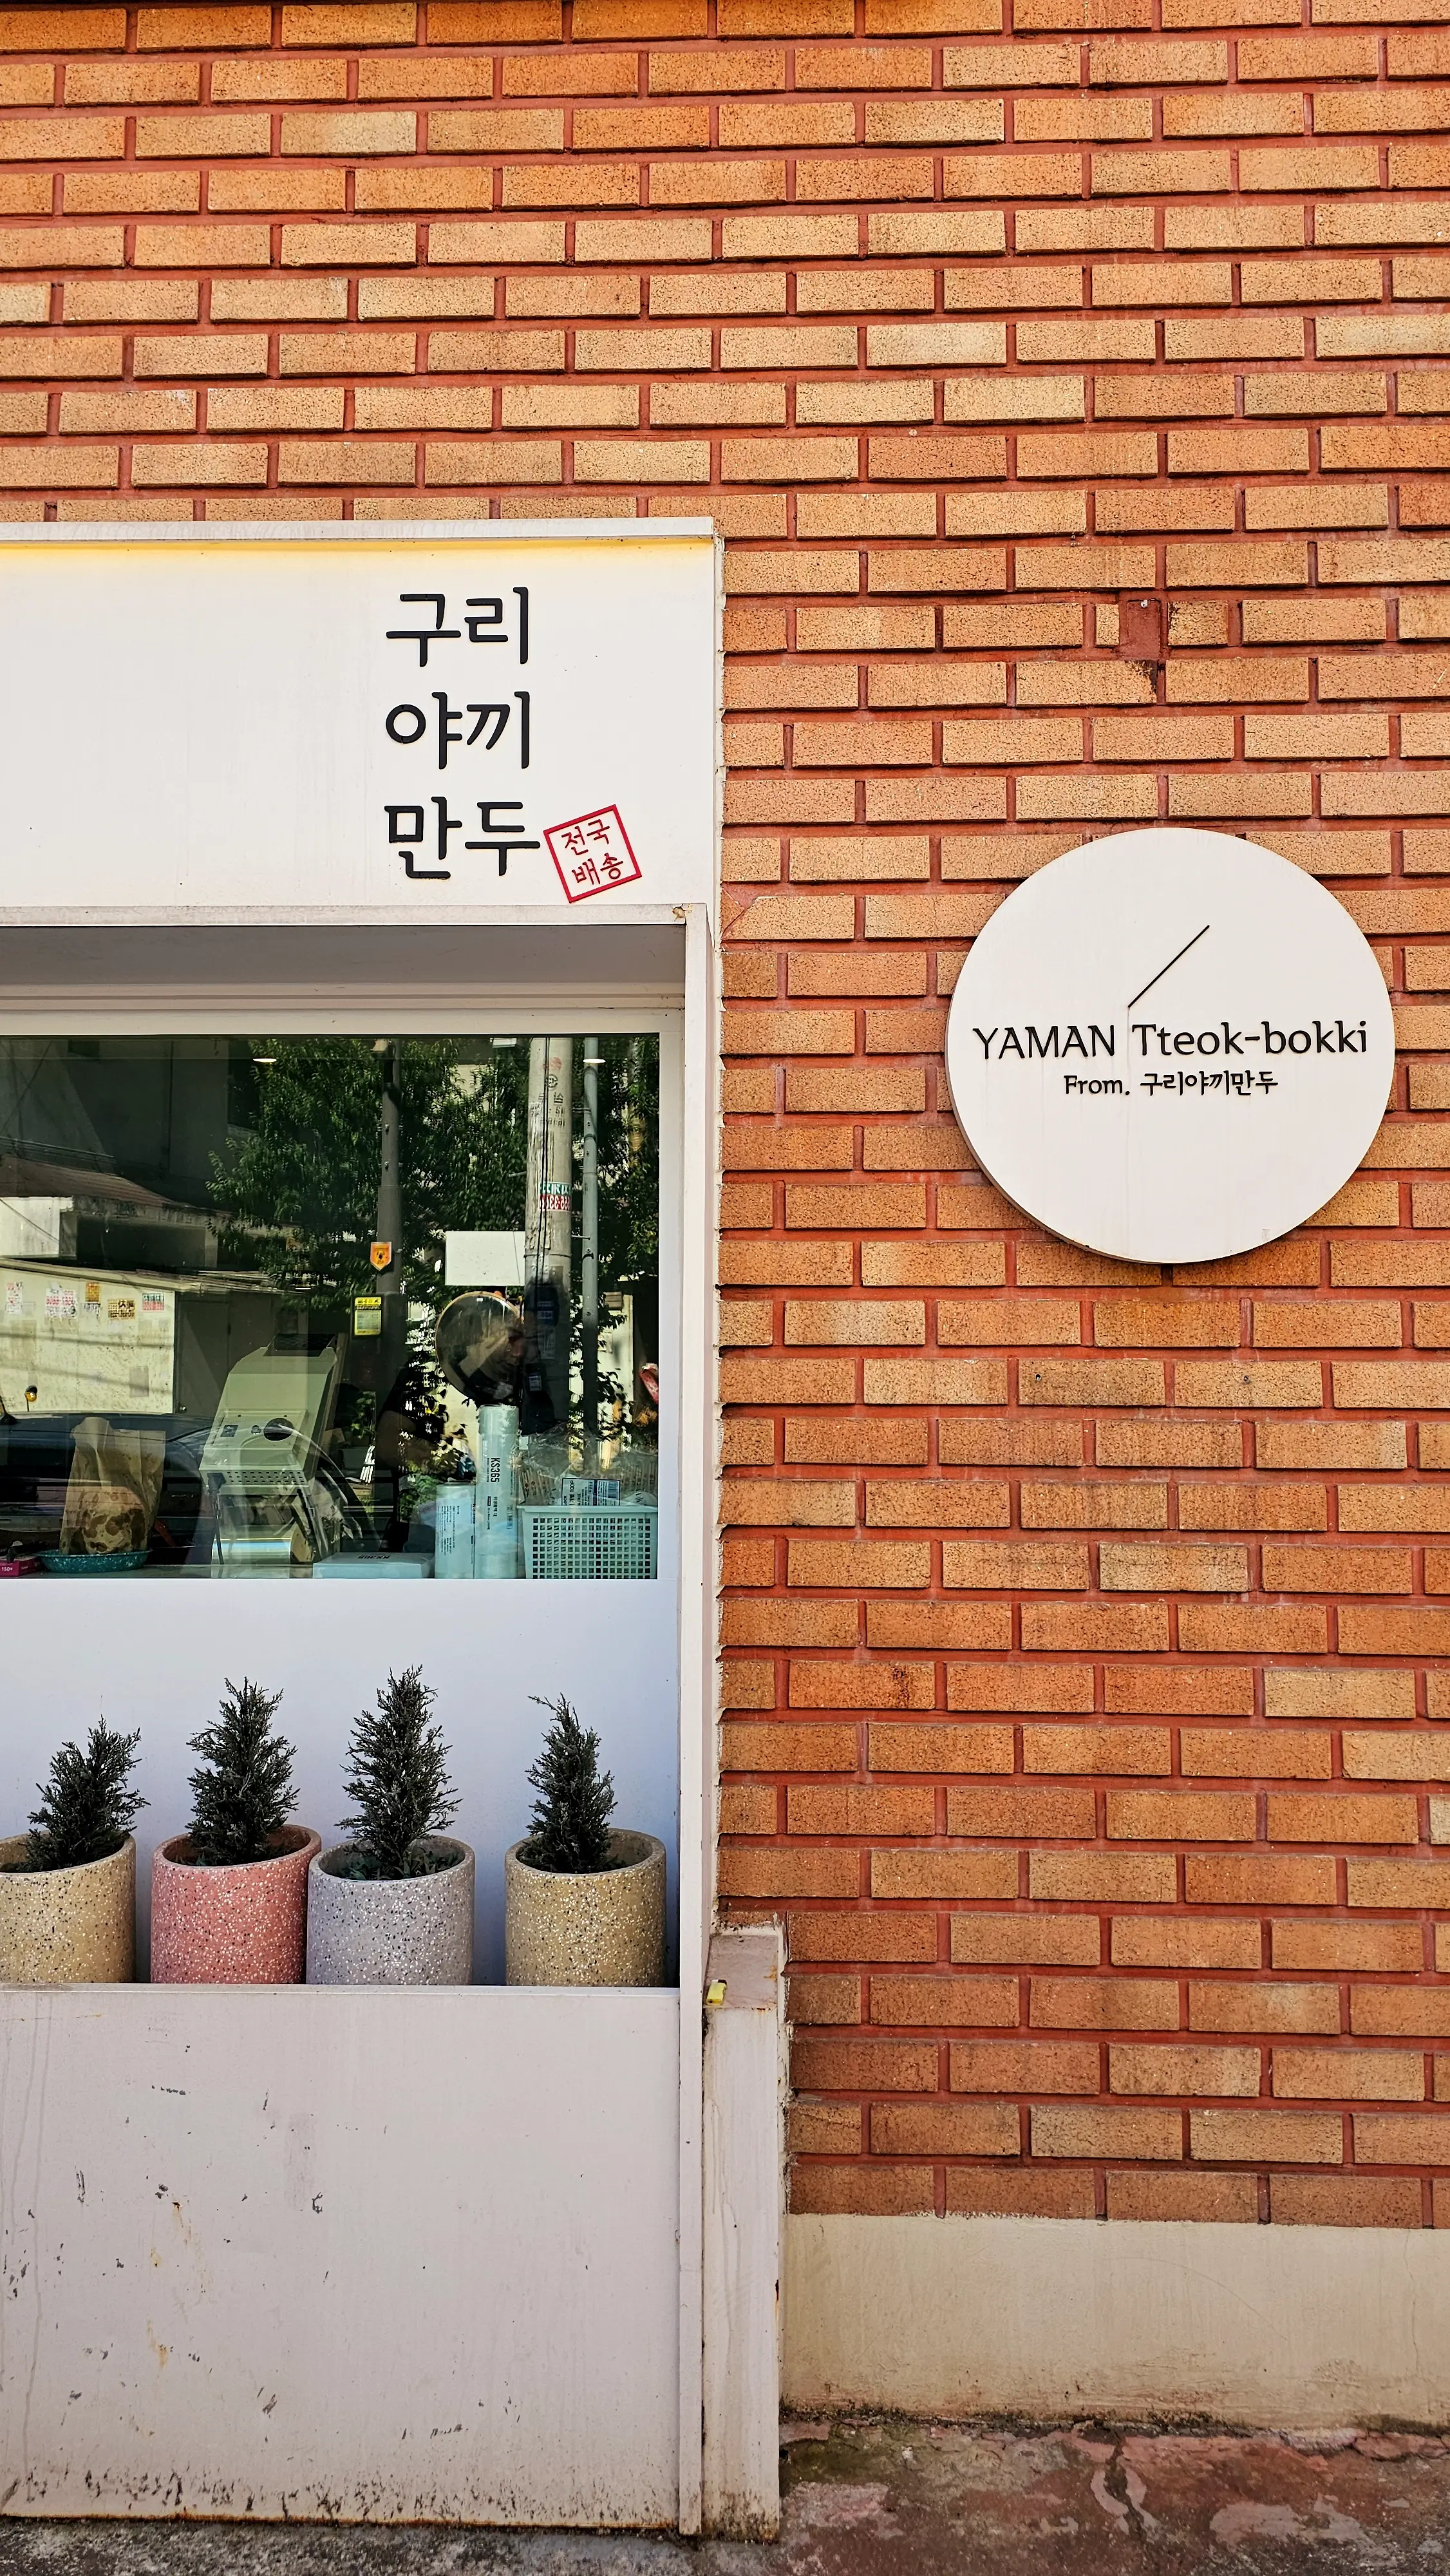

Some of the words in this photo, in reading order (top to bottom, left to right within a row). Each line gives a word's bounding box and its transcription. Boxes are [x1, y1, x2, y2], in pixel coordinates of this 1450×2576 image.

[386, 587, 529, 667] 구리
[385, 691, 531, 770] 야끼
[384, 796, 541, 880] 만두
[561, 819, 610, 856] 전국
[571, 852, 624, 886] 배송
[972, 1025, 1115, 1060] YAMAN
[1131, 1019, 1368, 1057] Tteok-bokki
[1063, 1075, 1131, 1096] From.
[1140, 1070, 1279, 1097] 구리야끼만두
[490, 1457, 500, 1482] KS365
